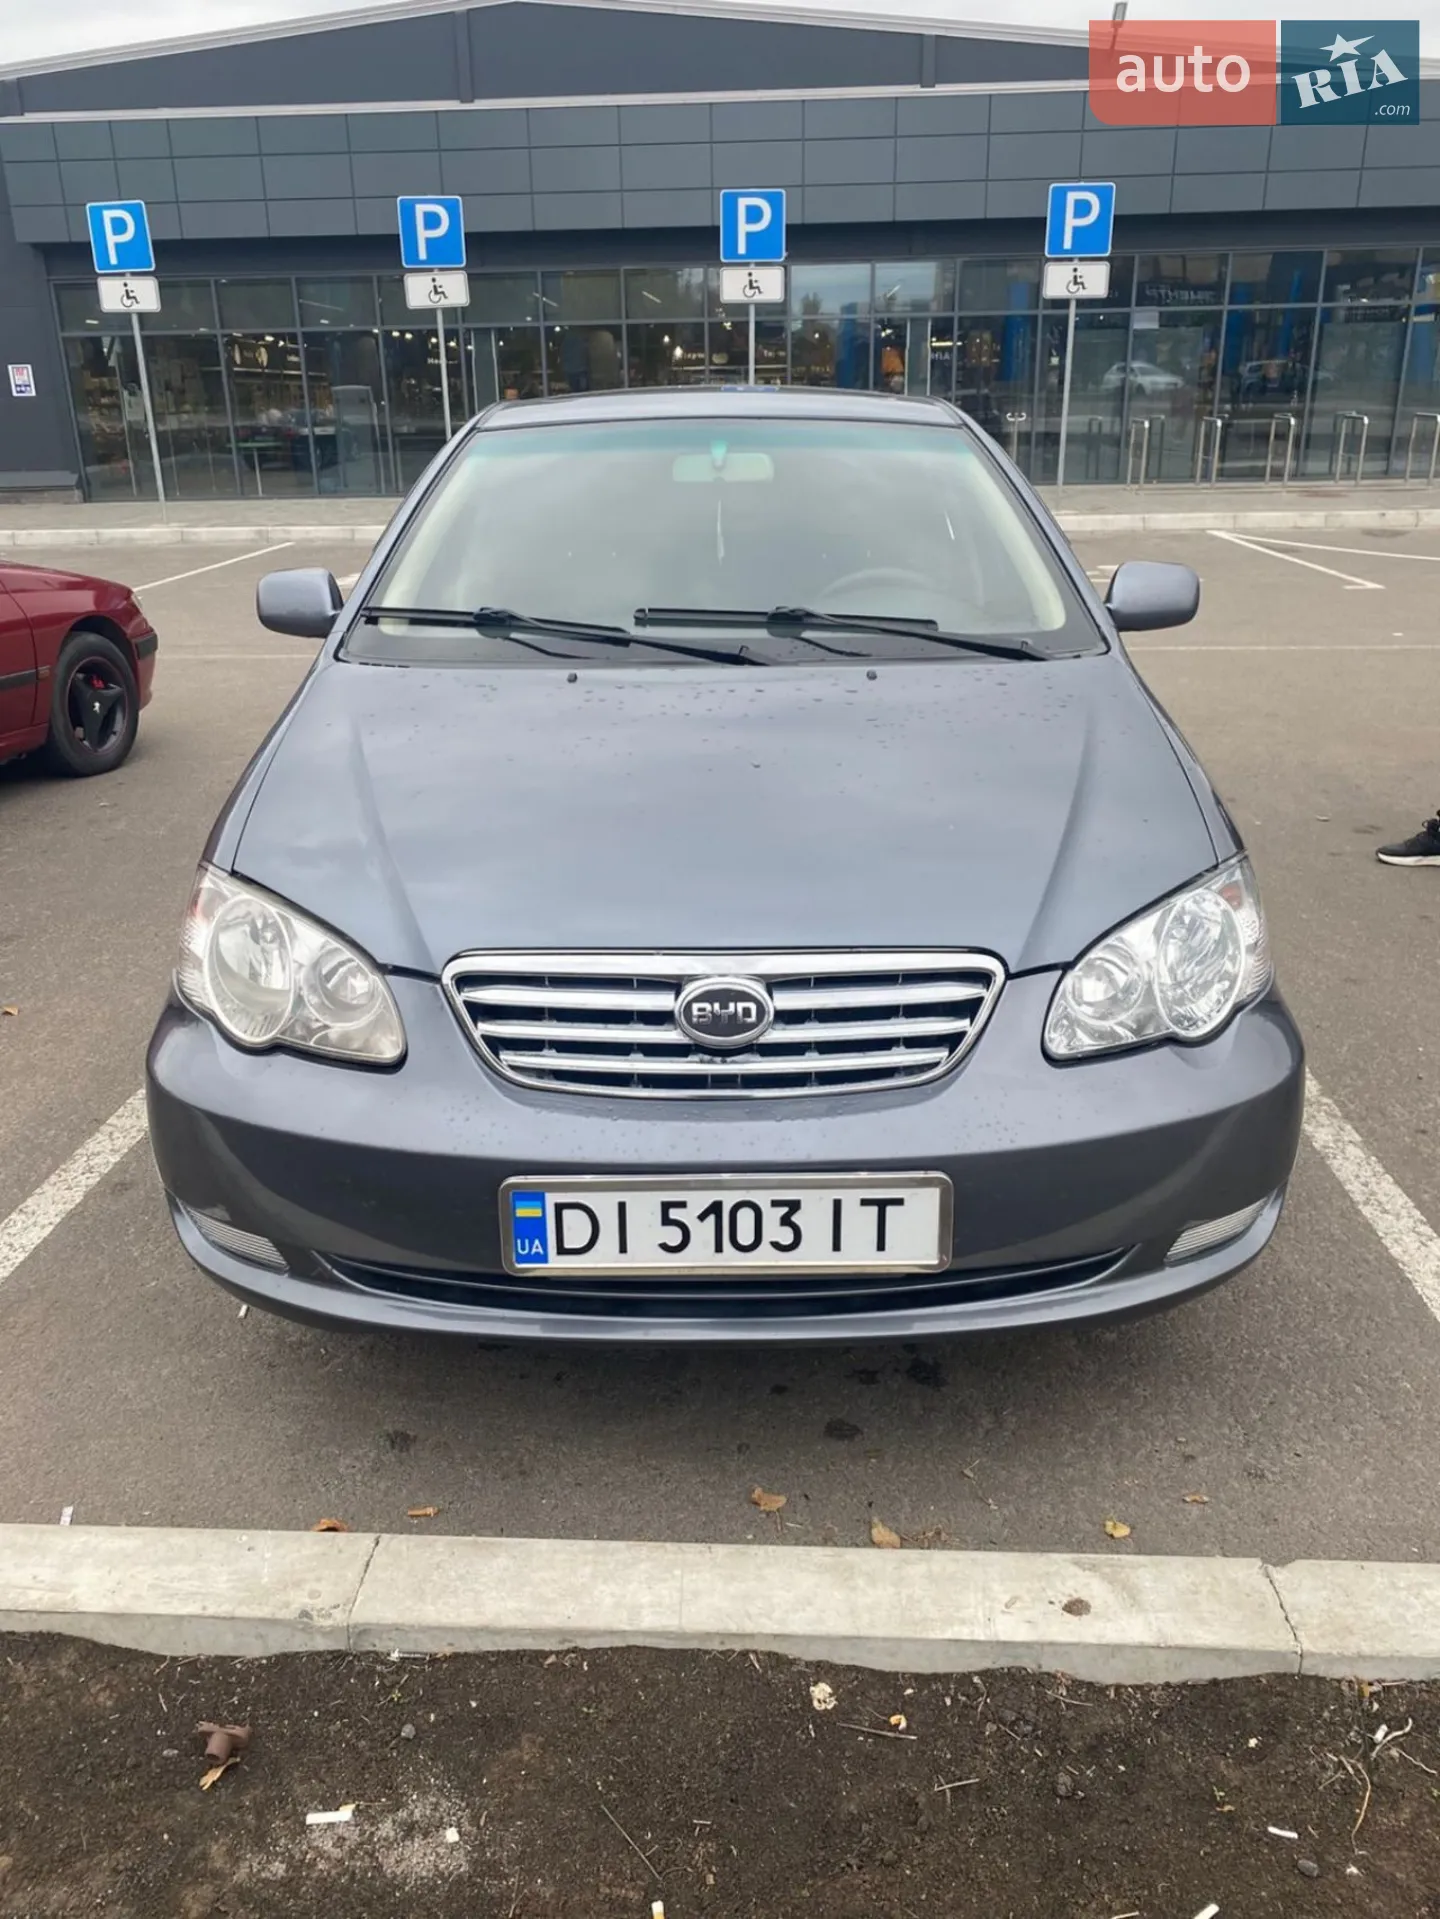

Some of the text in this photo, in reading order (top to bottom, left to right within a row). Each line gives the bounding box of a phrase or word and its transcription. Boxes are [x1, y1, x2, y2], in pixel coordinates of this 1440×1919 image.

[103, 209, 135, 265] P
[415, 204, 450, 260] P
[738, 197, 772, 255] P
[1063, 191, 1100, 249] P
[692, 1002, 757, 1024] BYD
[517, 1239, 543, 1255] UA
[554, 1198, 905, 1254] DI 5103 IT
